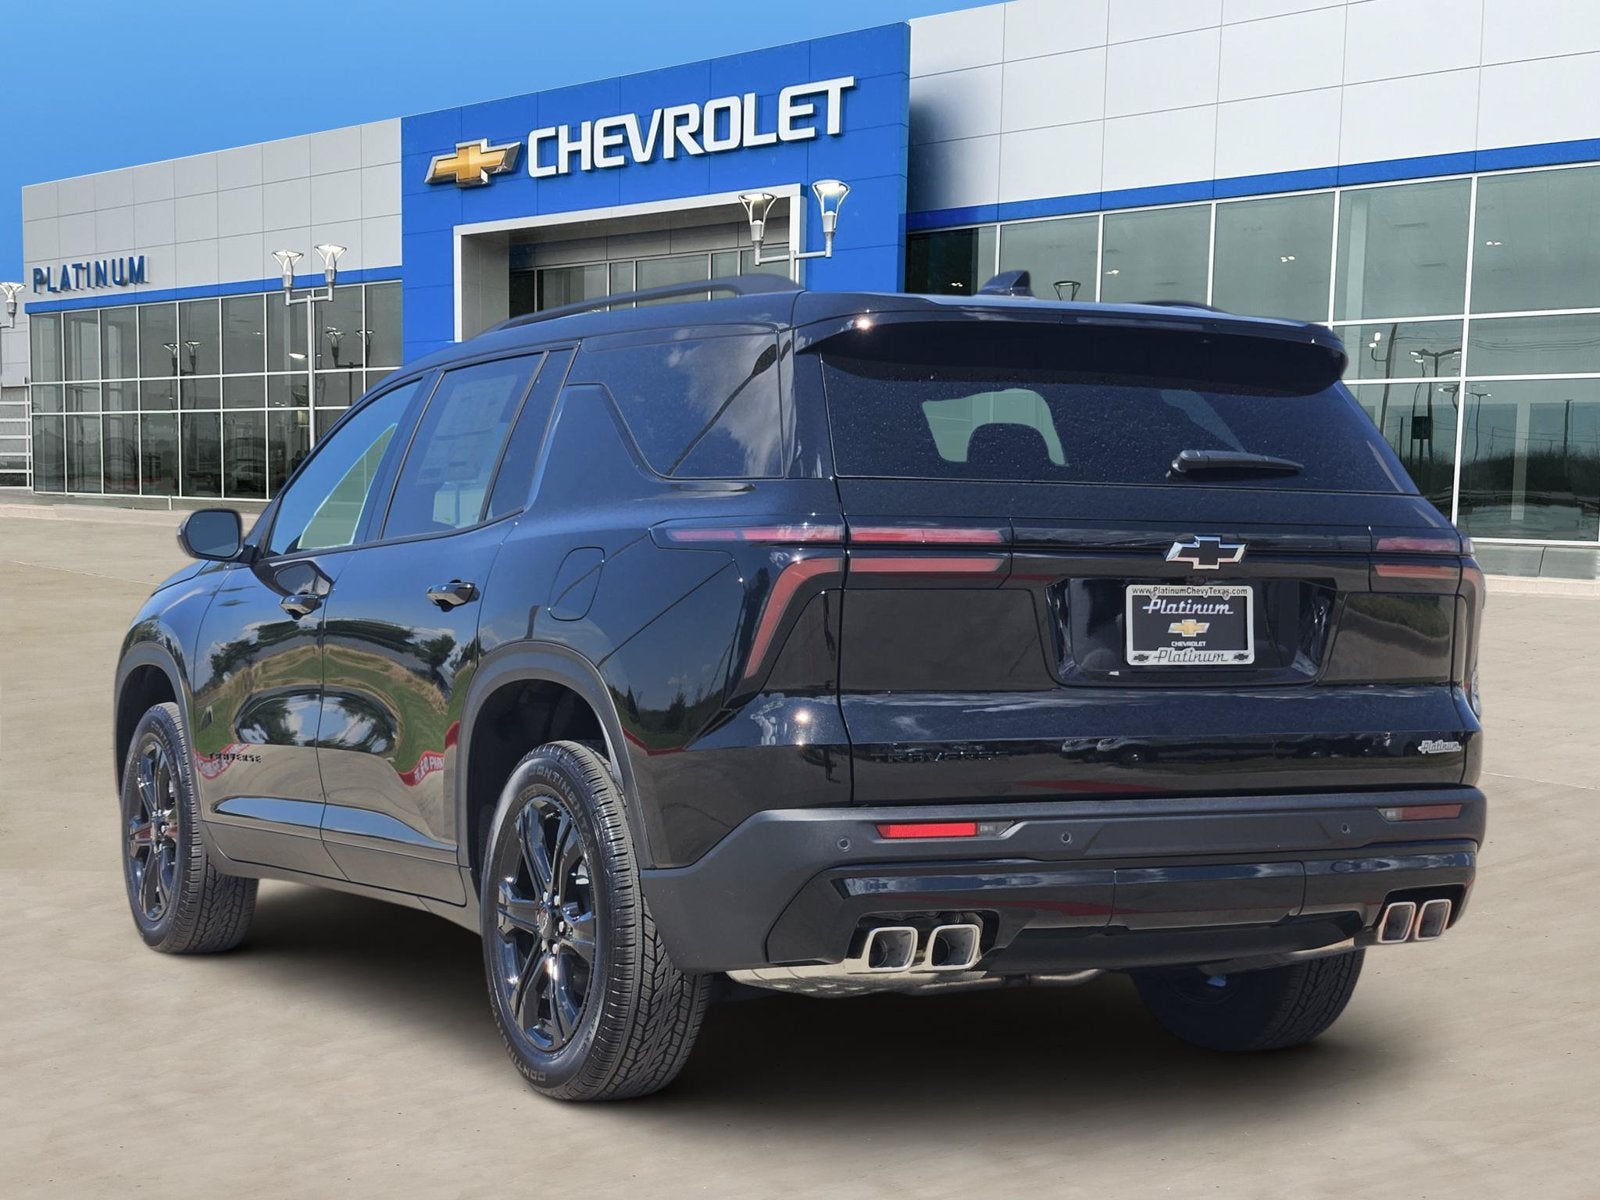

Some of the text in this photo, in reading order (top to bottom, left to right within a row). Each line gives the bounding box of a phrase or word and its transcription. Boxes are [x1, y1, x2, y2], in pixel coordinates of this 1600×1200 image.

[527, 75, 855, 178] CHEVROLET
[33, 255, 145, 293] PLATINUM
[1132, 586, 1248, 596] www.PlatinumChevyTexas.com
[1142, 599, 1234, 614] Platinum
[1153, 648, 1229, 663] Platinum
